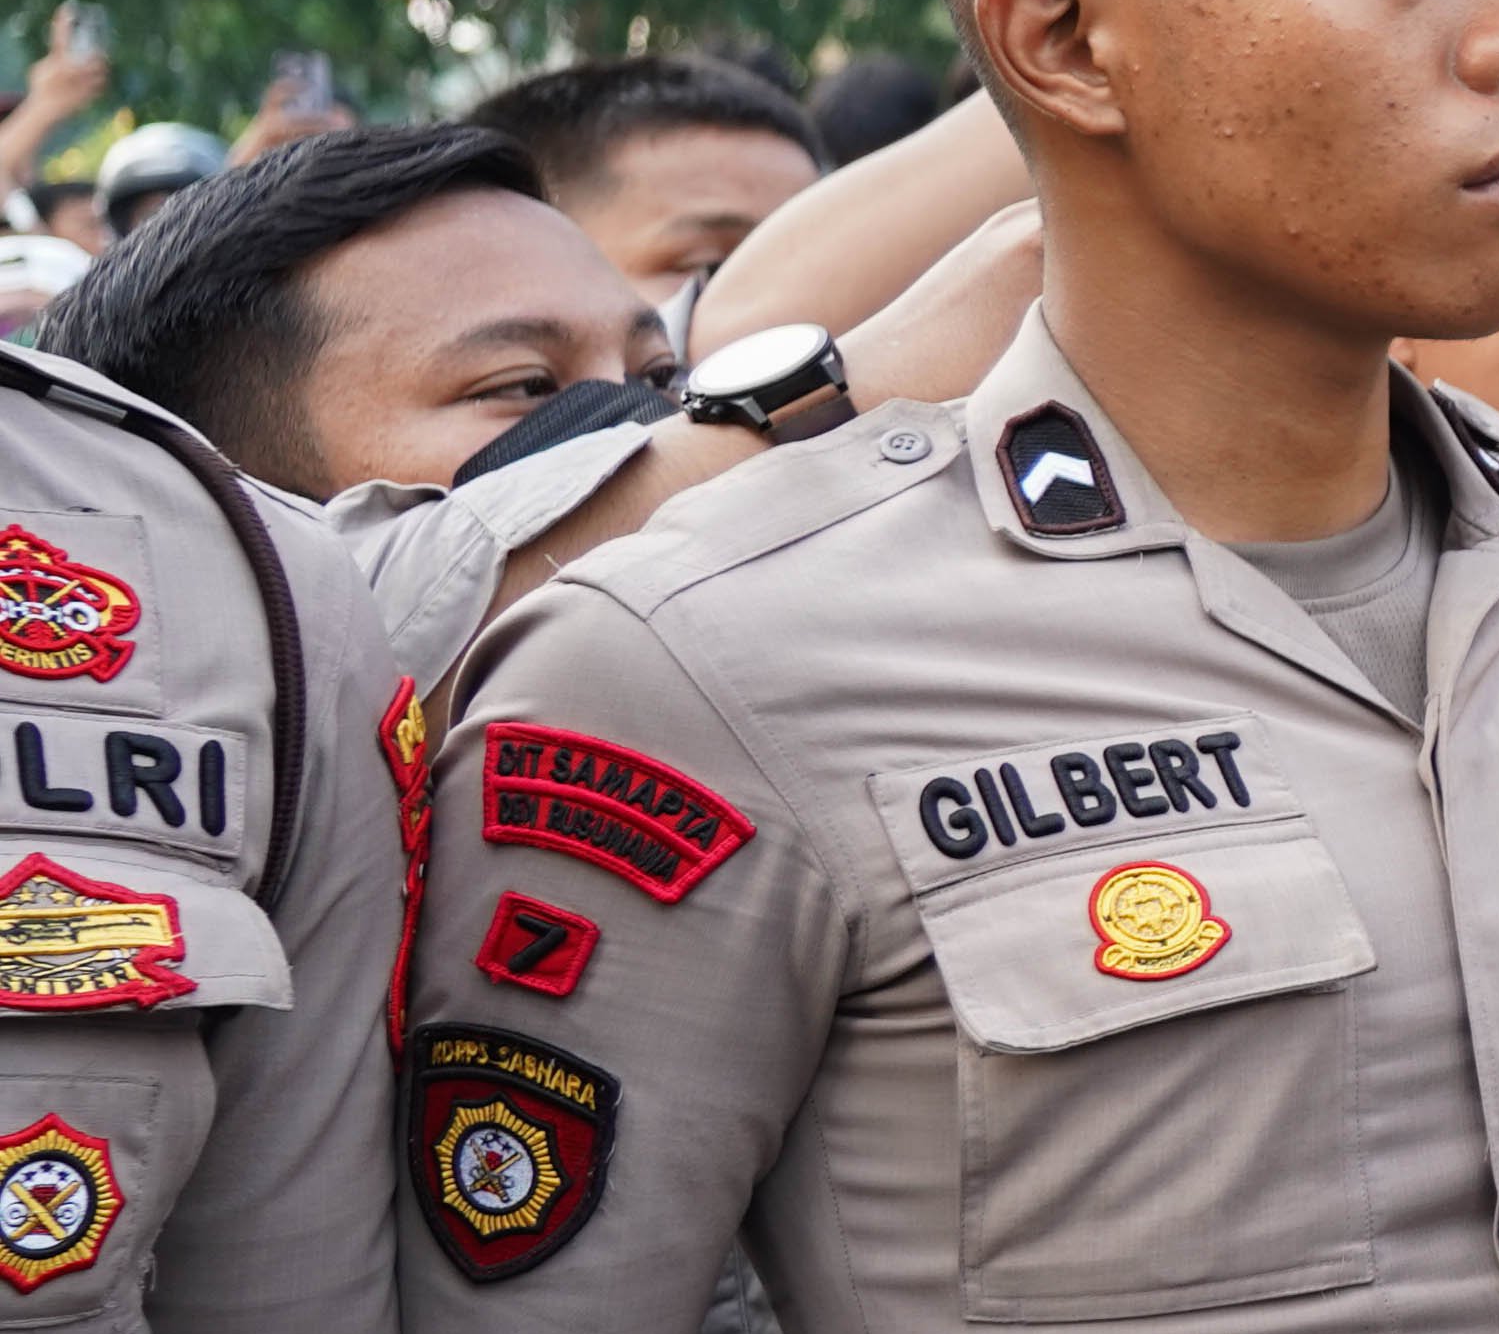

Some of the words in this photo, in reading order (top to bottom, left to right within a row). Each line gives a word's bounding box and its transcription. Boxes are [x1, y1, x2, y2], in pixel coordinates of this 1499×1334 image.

[0, 641, 94, 670] ERINTIS
[14, 721, 226, 837] LRI
[497, 742, 543, 777] DIT
[549, 747, 721, 849] SAMAPTA
[918, 731, 1251, 860] GILBERT
[507, 913, 568, 973] 7
